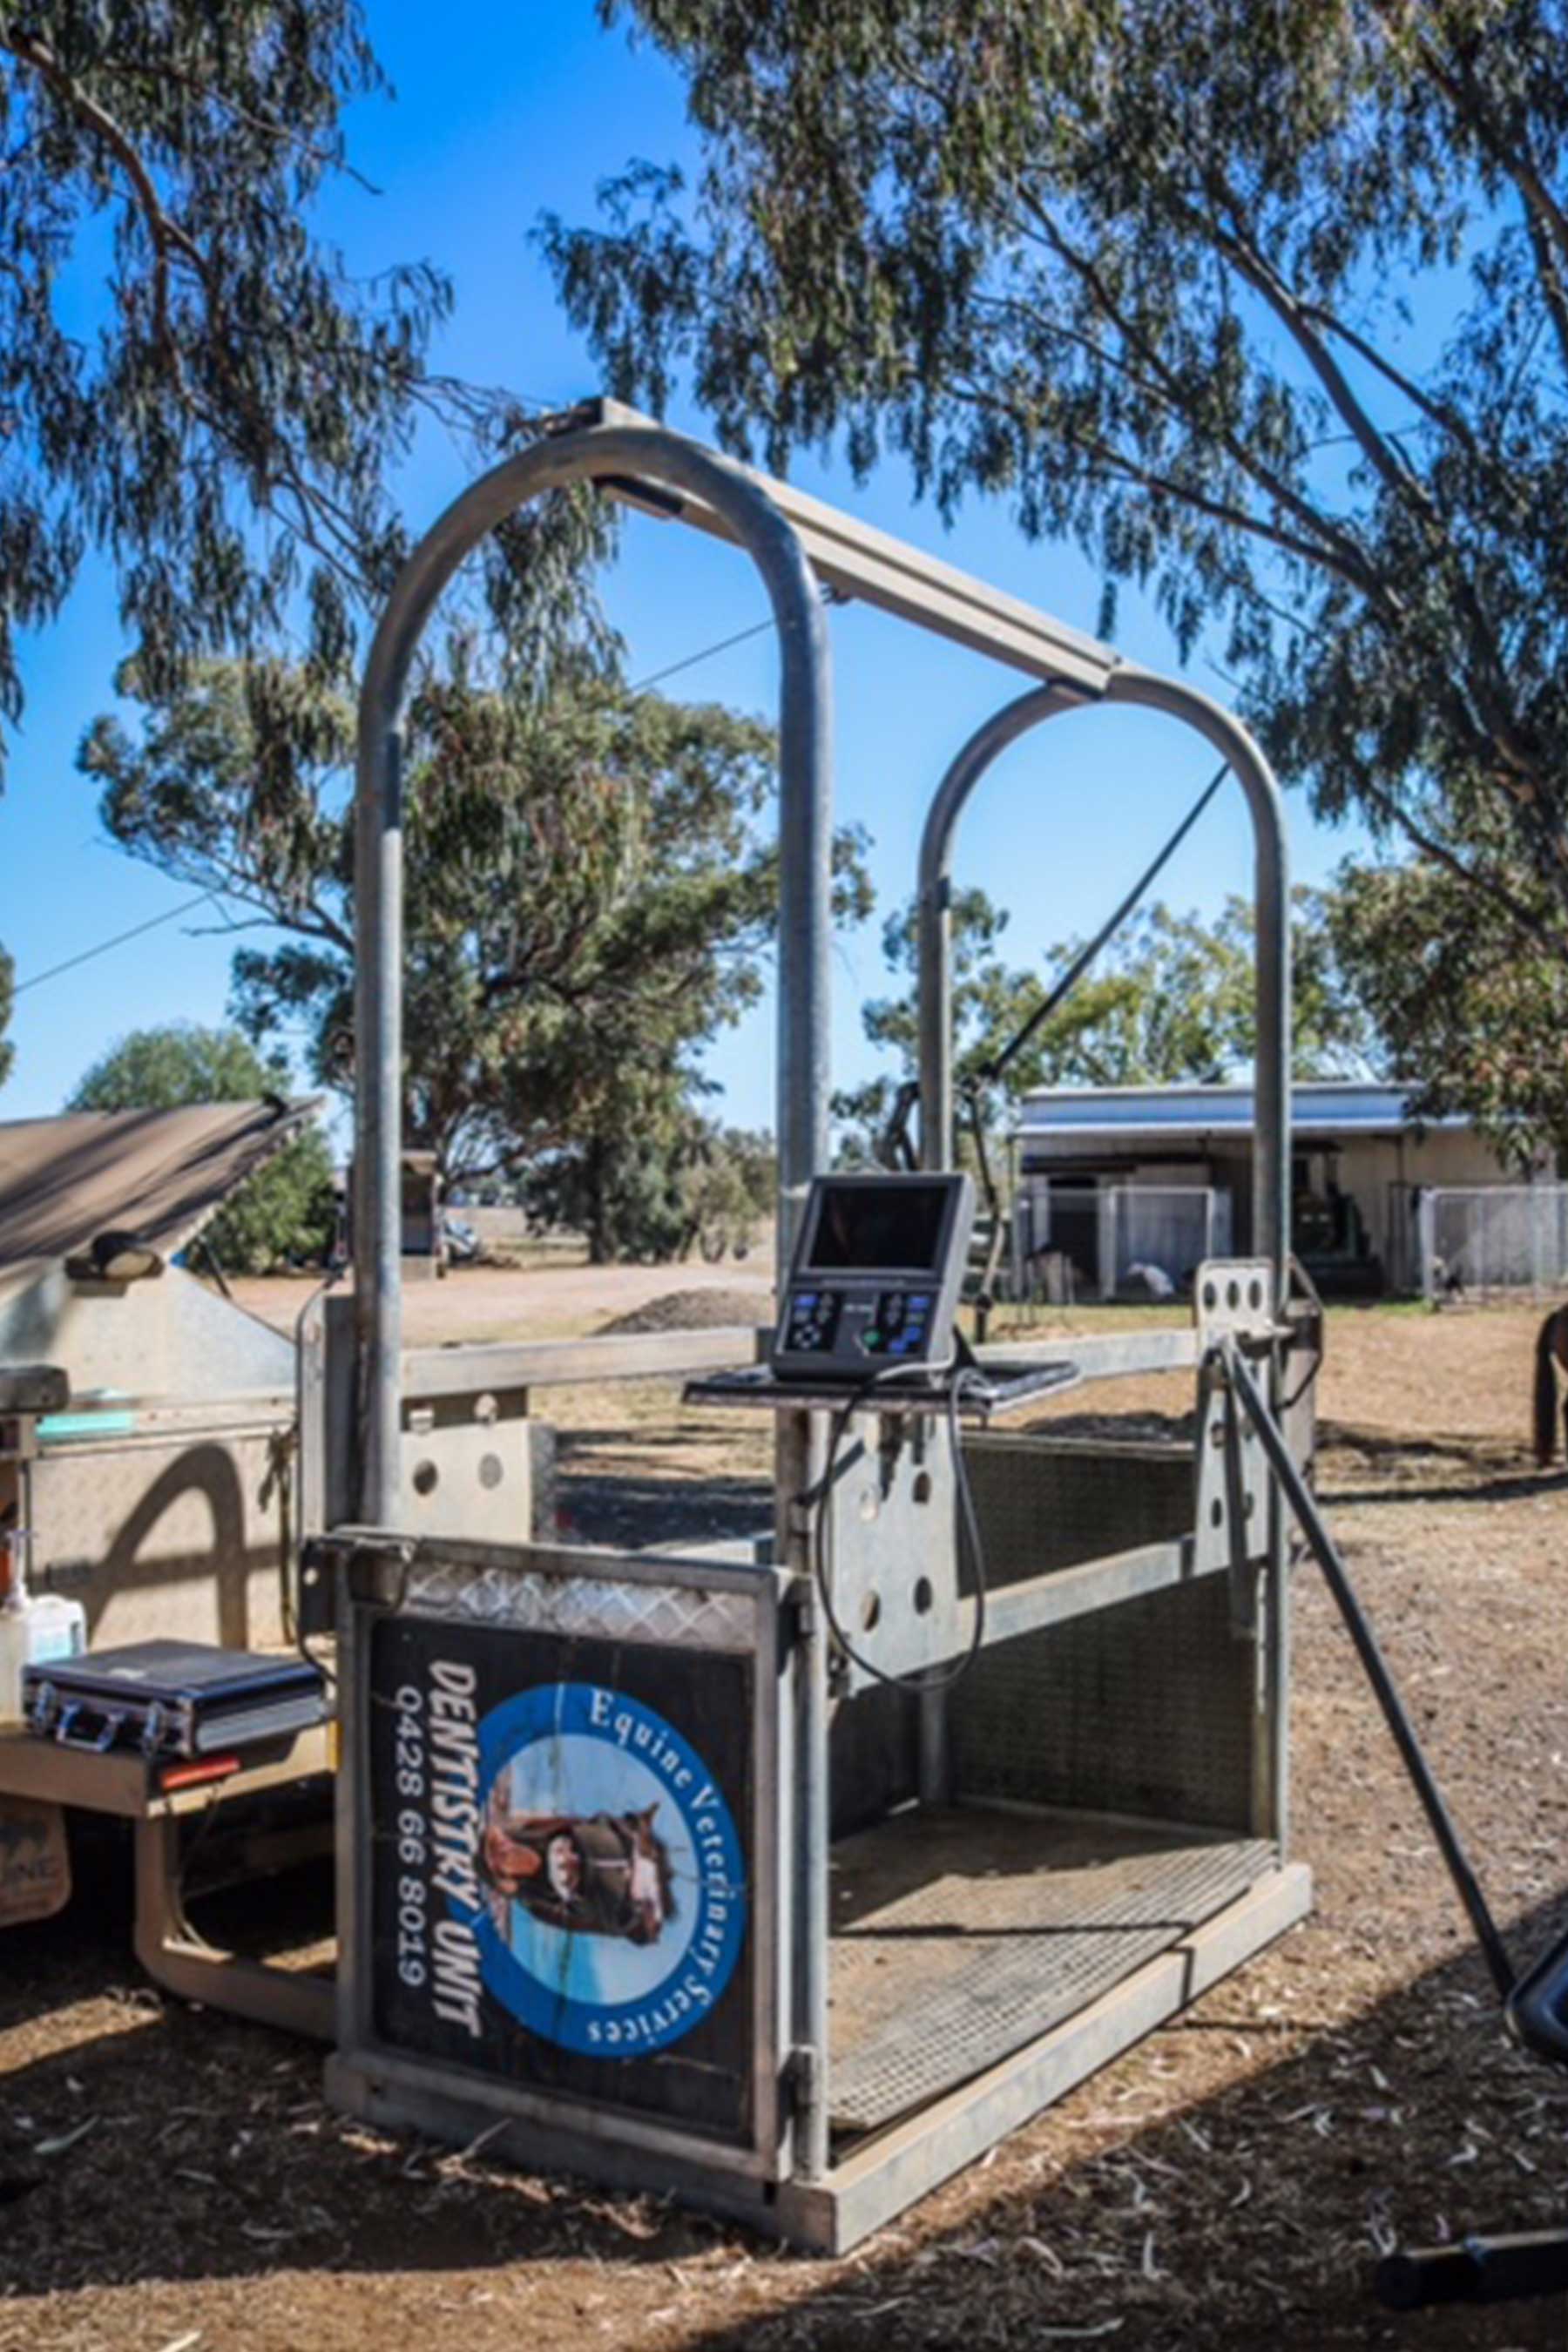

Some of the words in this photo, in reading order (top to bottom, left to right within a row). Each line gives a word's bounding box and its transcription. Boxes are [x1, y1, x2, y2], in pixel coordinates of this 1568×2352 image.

[396, 1686, 424, 1796] 0428
[429, 1659, 480, 1911] DENTISTRY
[590, 1686, 693, 1788] Equine
[398, 1809, 425, 1865] 66
[690, 1783, 735, 1976] Veterinary
[398, 1876, 426, 1986] 8019
[432, 1920, 482, 2038] UNIT
[588, 1975, 713, 2044] Services
